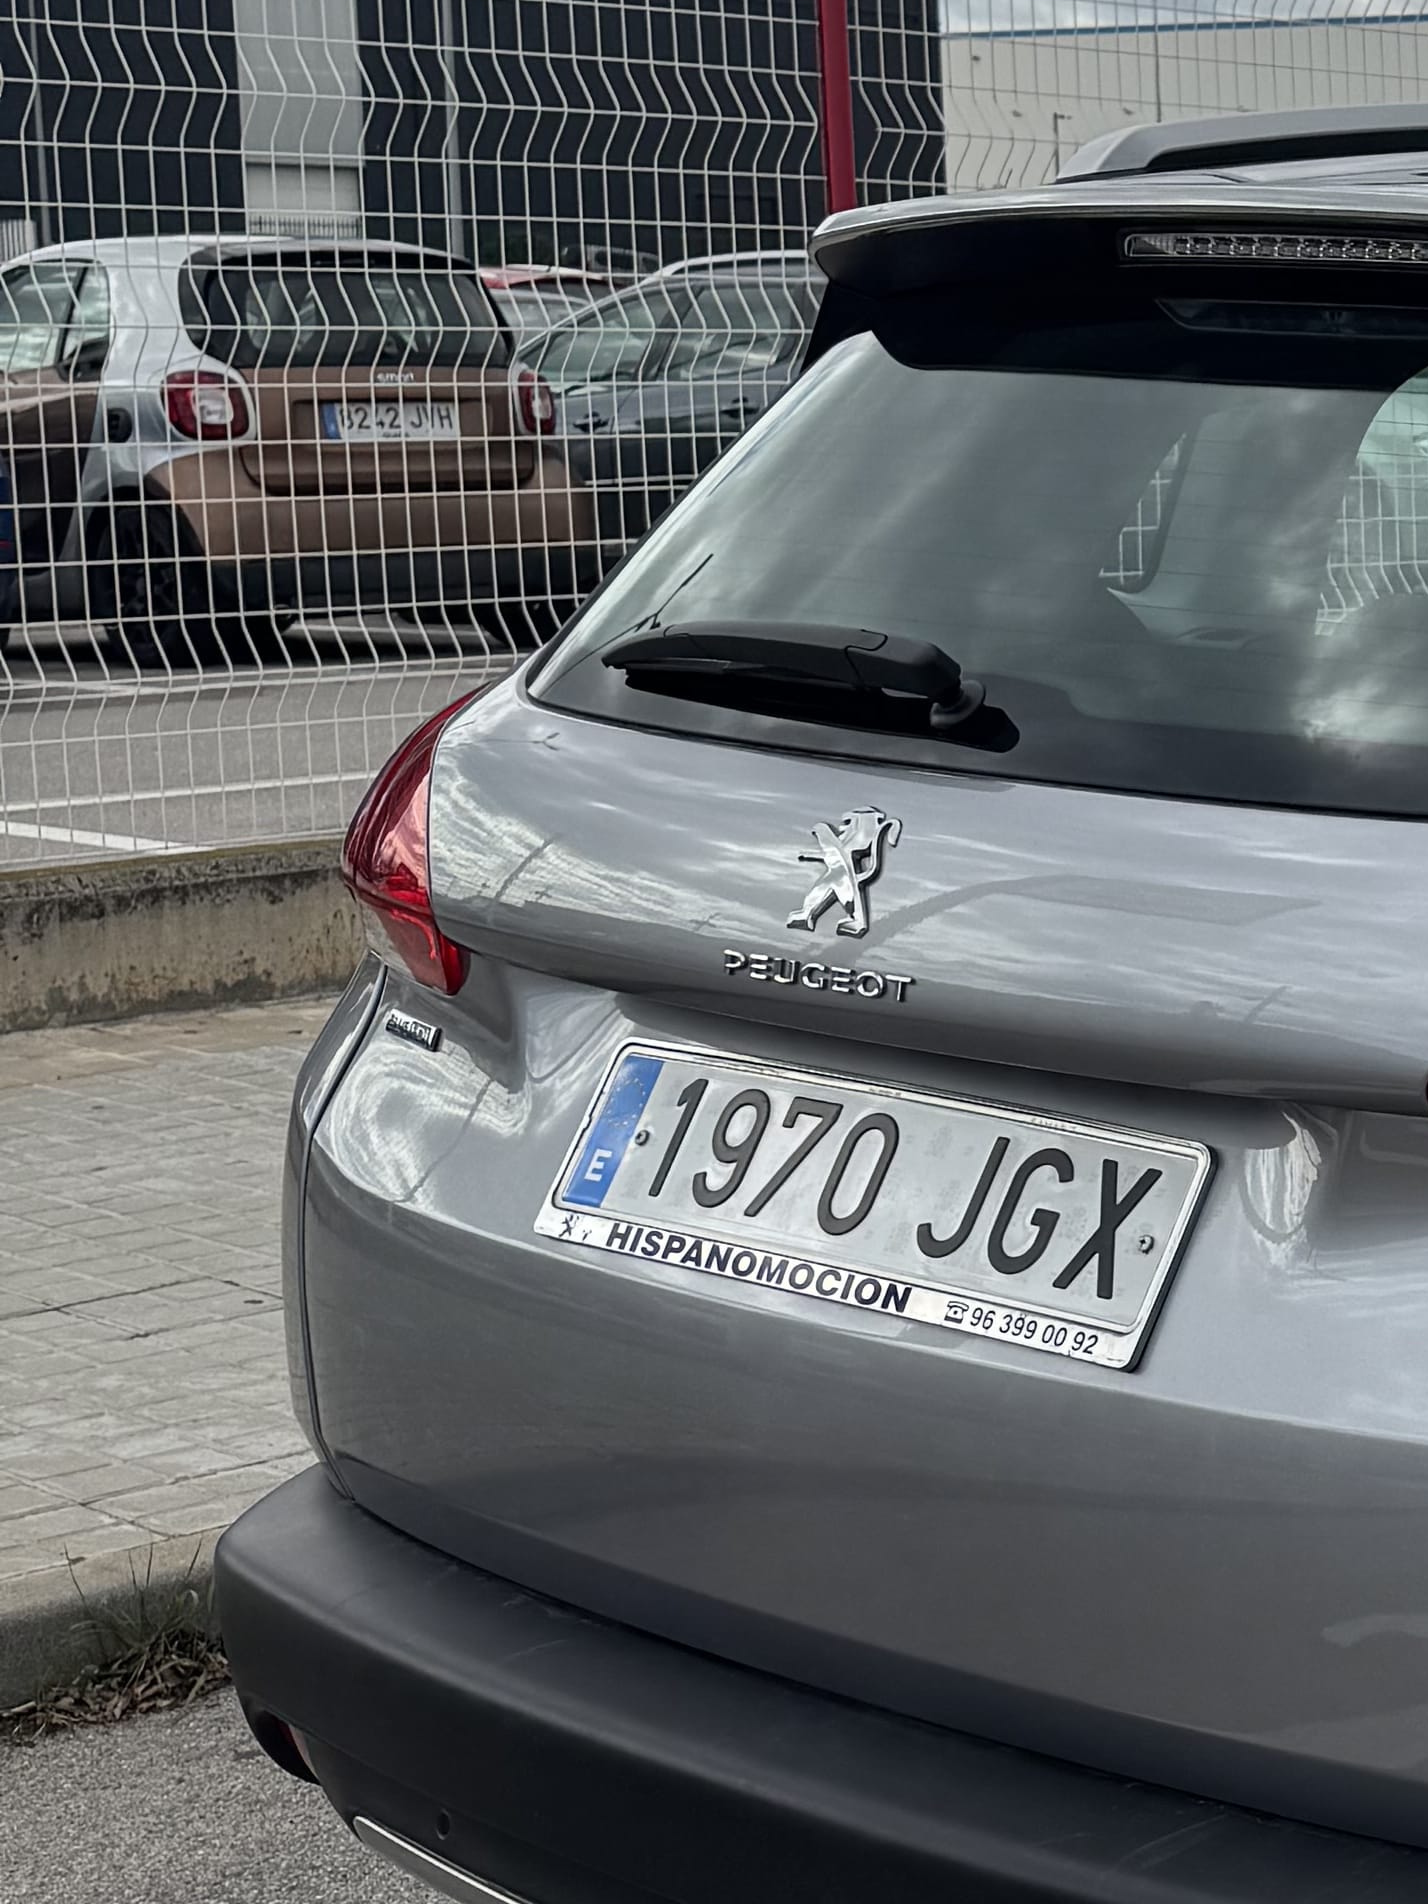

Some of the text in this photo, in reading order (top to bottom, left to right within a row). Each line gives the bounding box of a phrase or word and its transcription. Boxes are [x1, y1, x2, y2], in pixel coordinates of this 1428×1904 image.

[724, 948, 915, 1002] PEUGEOT
[584, 1148, 612, 1182] E
[648, 1078, 1162, 1300] 1970 JGX
[605, 1223, 1098, 1355] HISPANOMOCION 96 399 00 92
